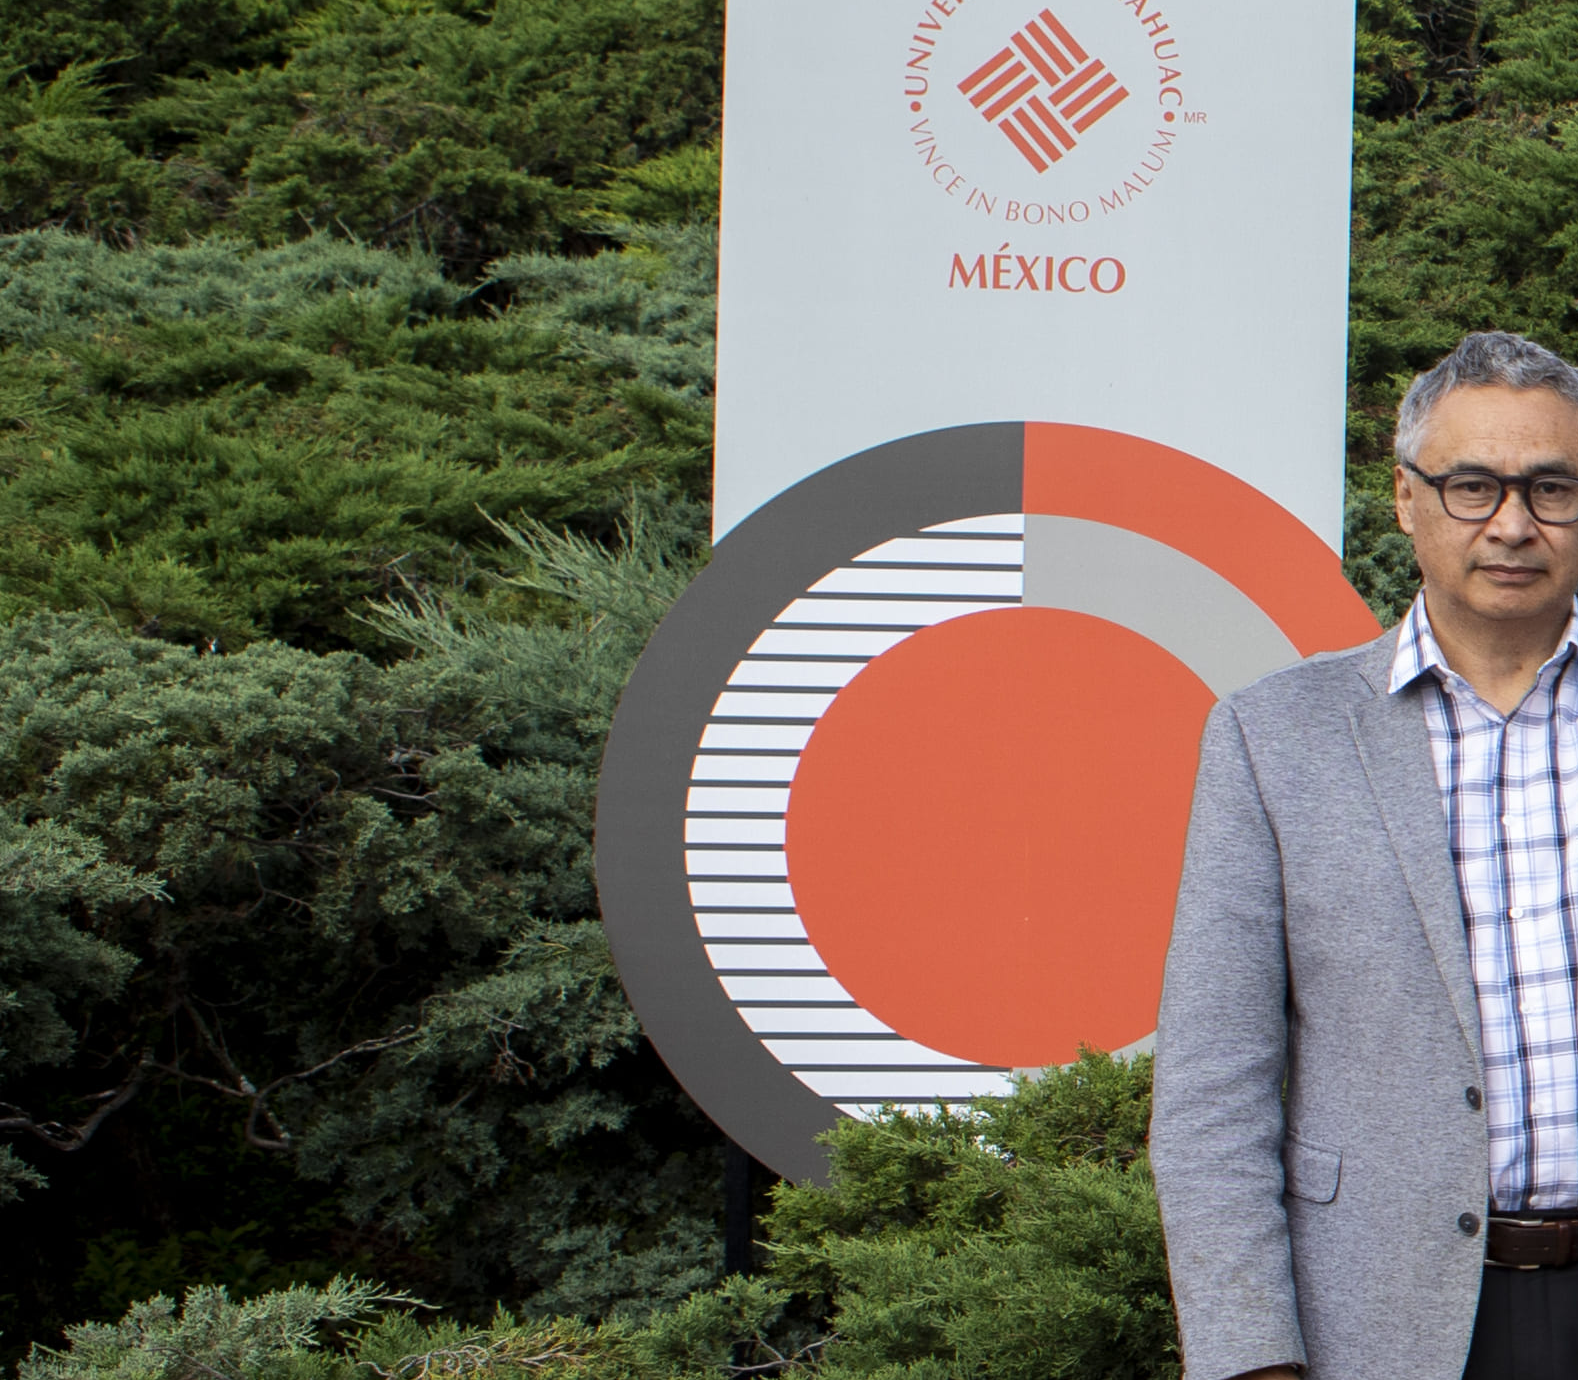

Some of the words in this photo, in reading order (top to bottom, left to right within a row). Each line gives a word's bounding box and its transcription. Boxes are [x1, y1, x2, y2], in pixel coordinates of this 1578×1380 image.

[1184, 111, 1207, 123] MR
[910, 118, 965, 194] VINCE
[966, 188, 997, 214] IN
[1005, 200, 1090, 224] BONO
[1098, 129, 1176, 213] MALUM
[948, 241, 1127, 294] MÉXICO
